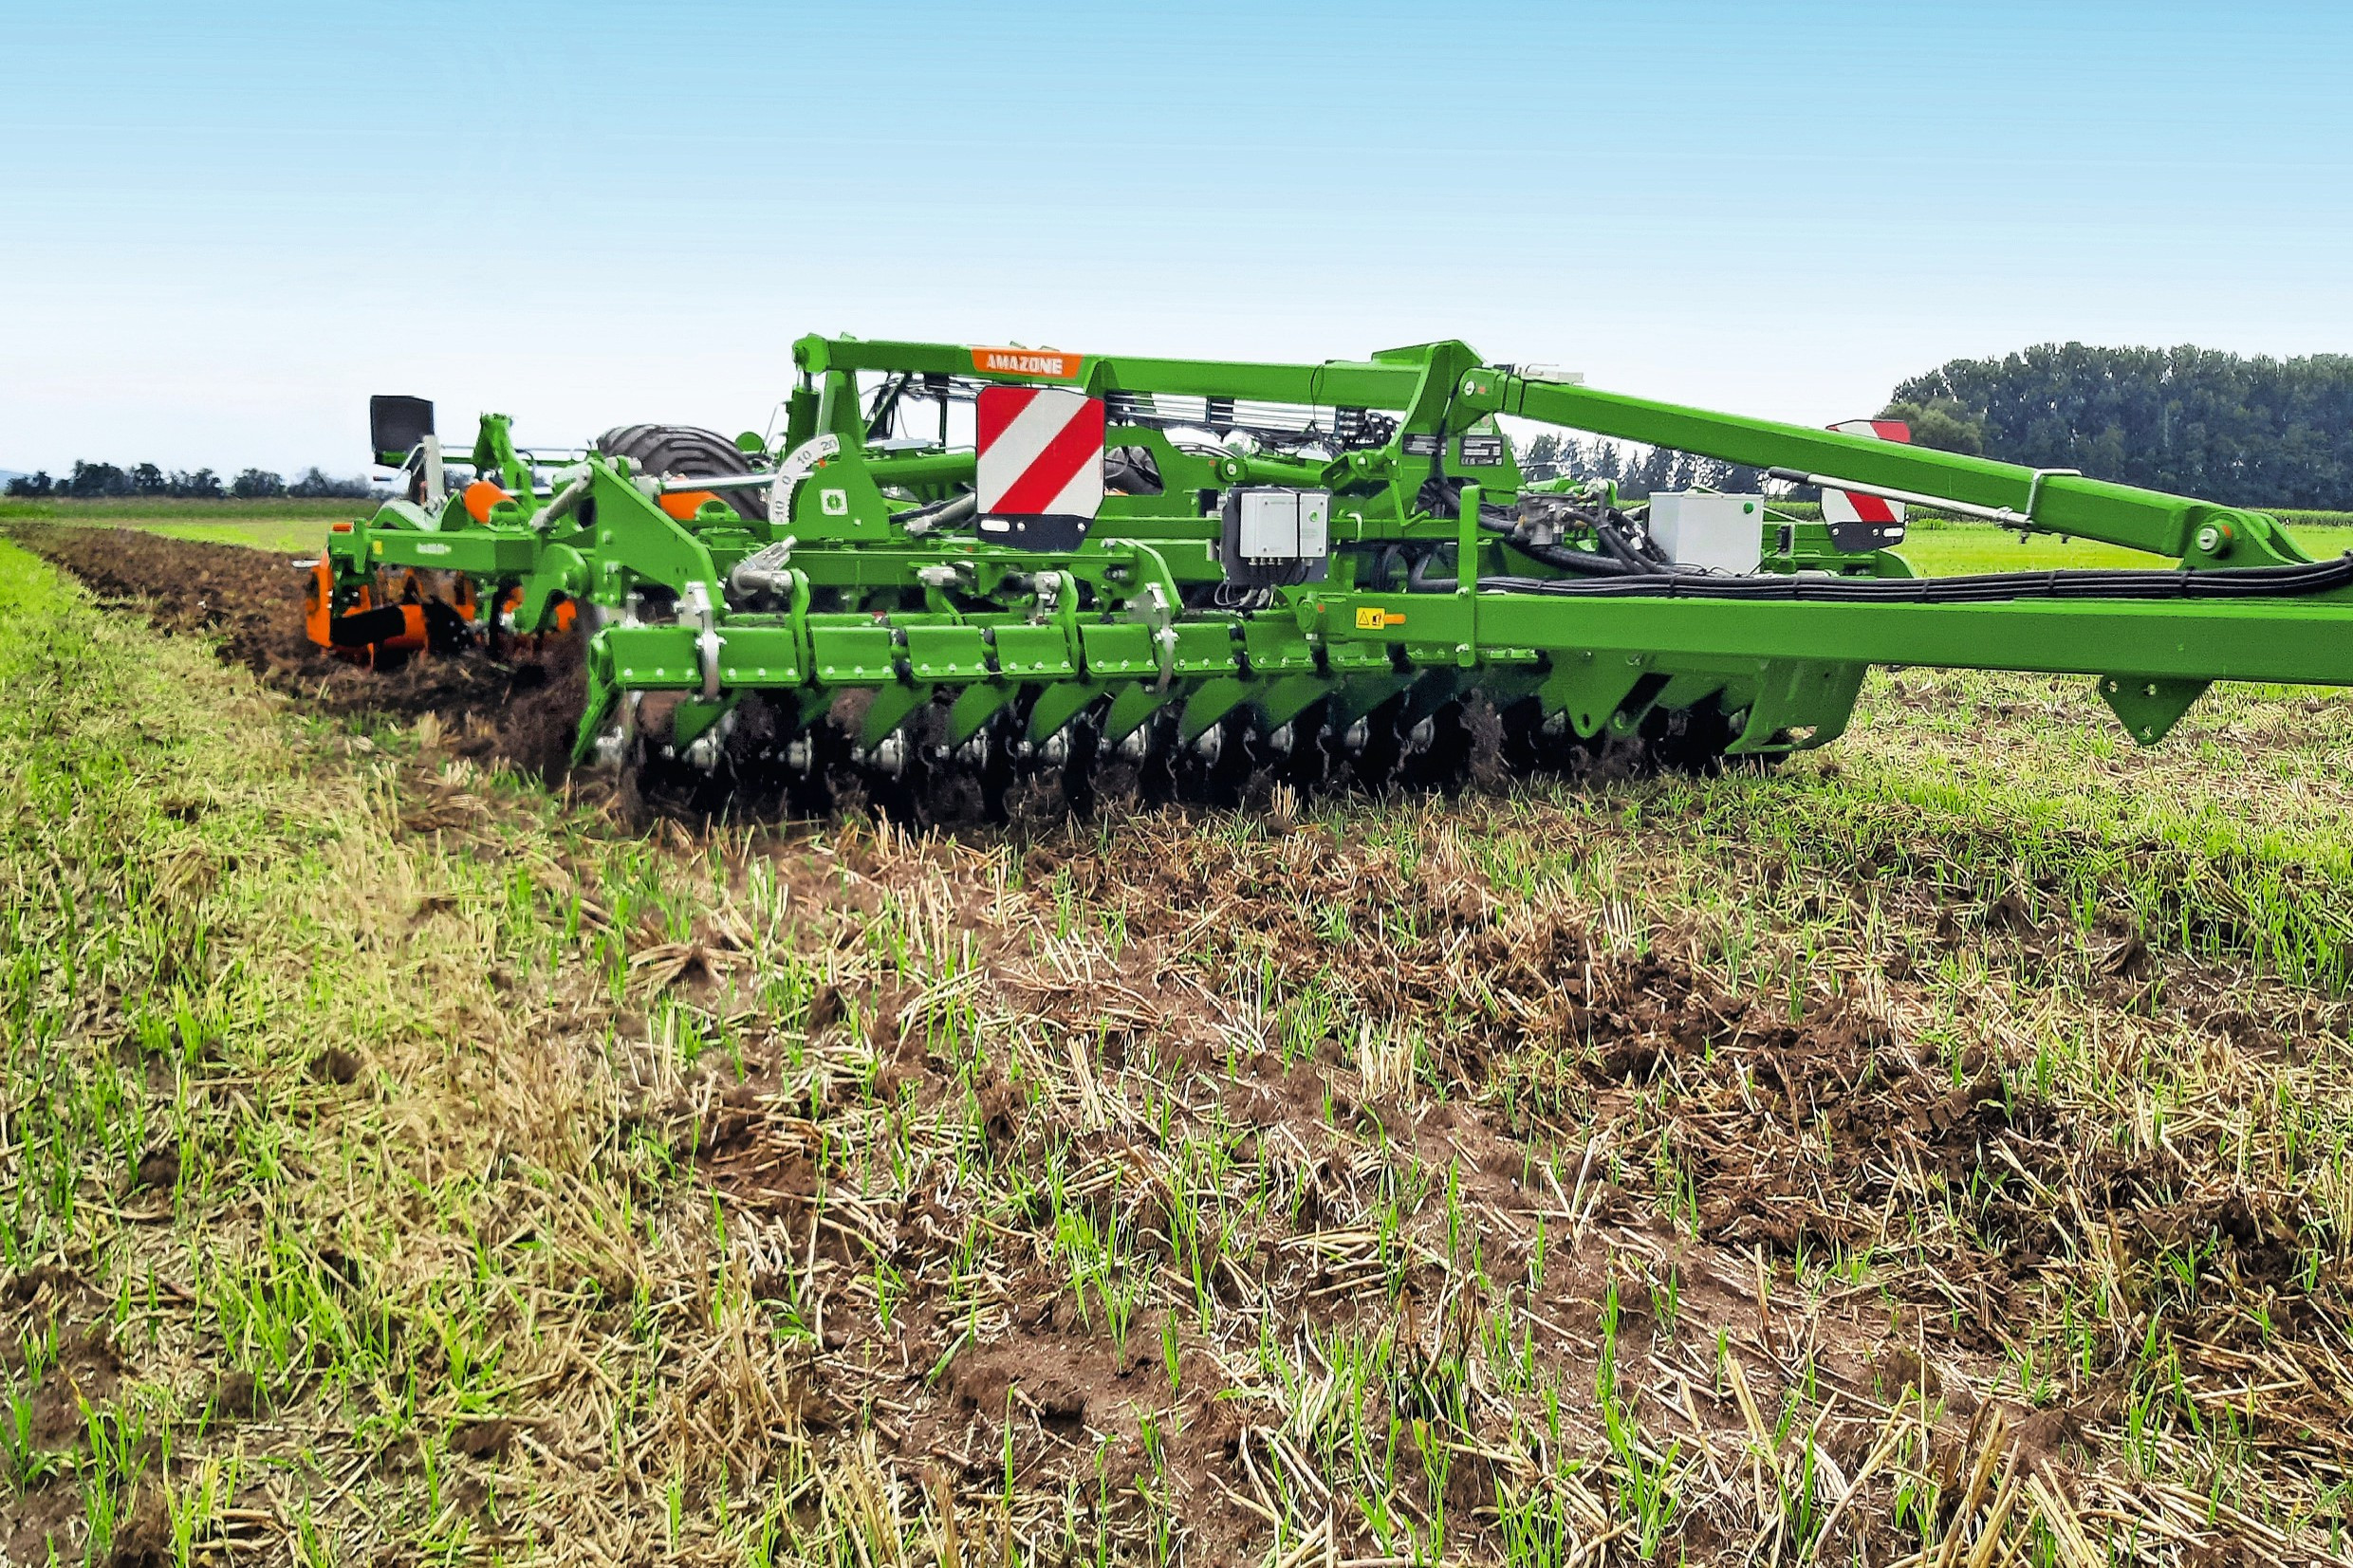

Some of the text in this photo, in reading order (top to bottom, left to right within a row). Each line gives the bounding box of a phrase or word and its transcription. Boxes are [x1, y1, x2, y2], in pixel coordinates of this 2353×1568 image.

[987, 353, 1063, 375] AMAZONE
[820, 439, 837, 452] 20
[797, 450, 812, 464] 10
[782, 475, 791, 485] 0
